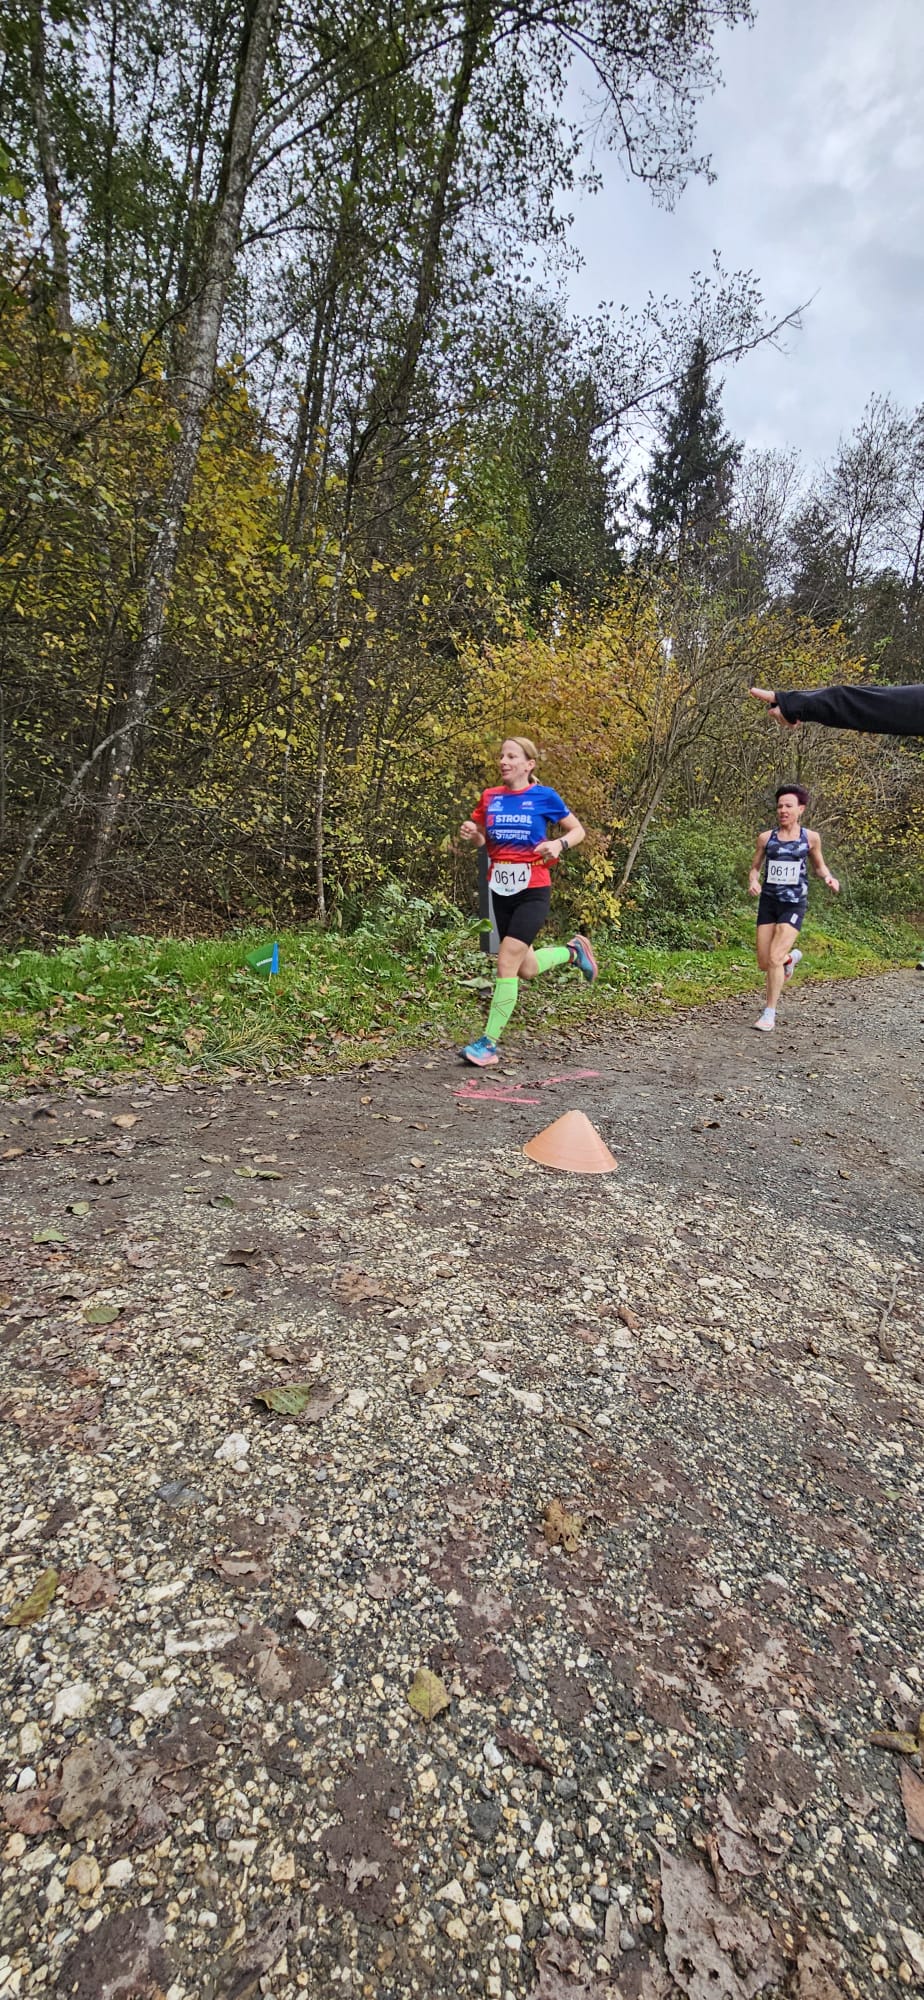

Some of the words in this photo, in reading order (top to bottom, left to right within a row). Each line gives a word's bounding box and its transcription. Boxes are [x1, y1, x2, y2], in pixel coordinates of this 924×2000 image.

[496, 814, 532, 824] STROBL
[770, 865, 795, 877] 0611
[494, 870, 526, 885] 0614
